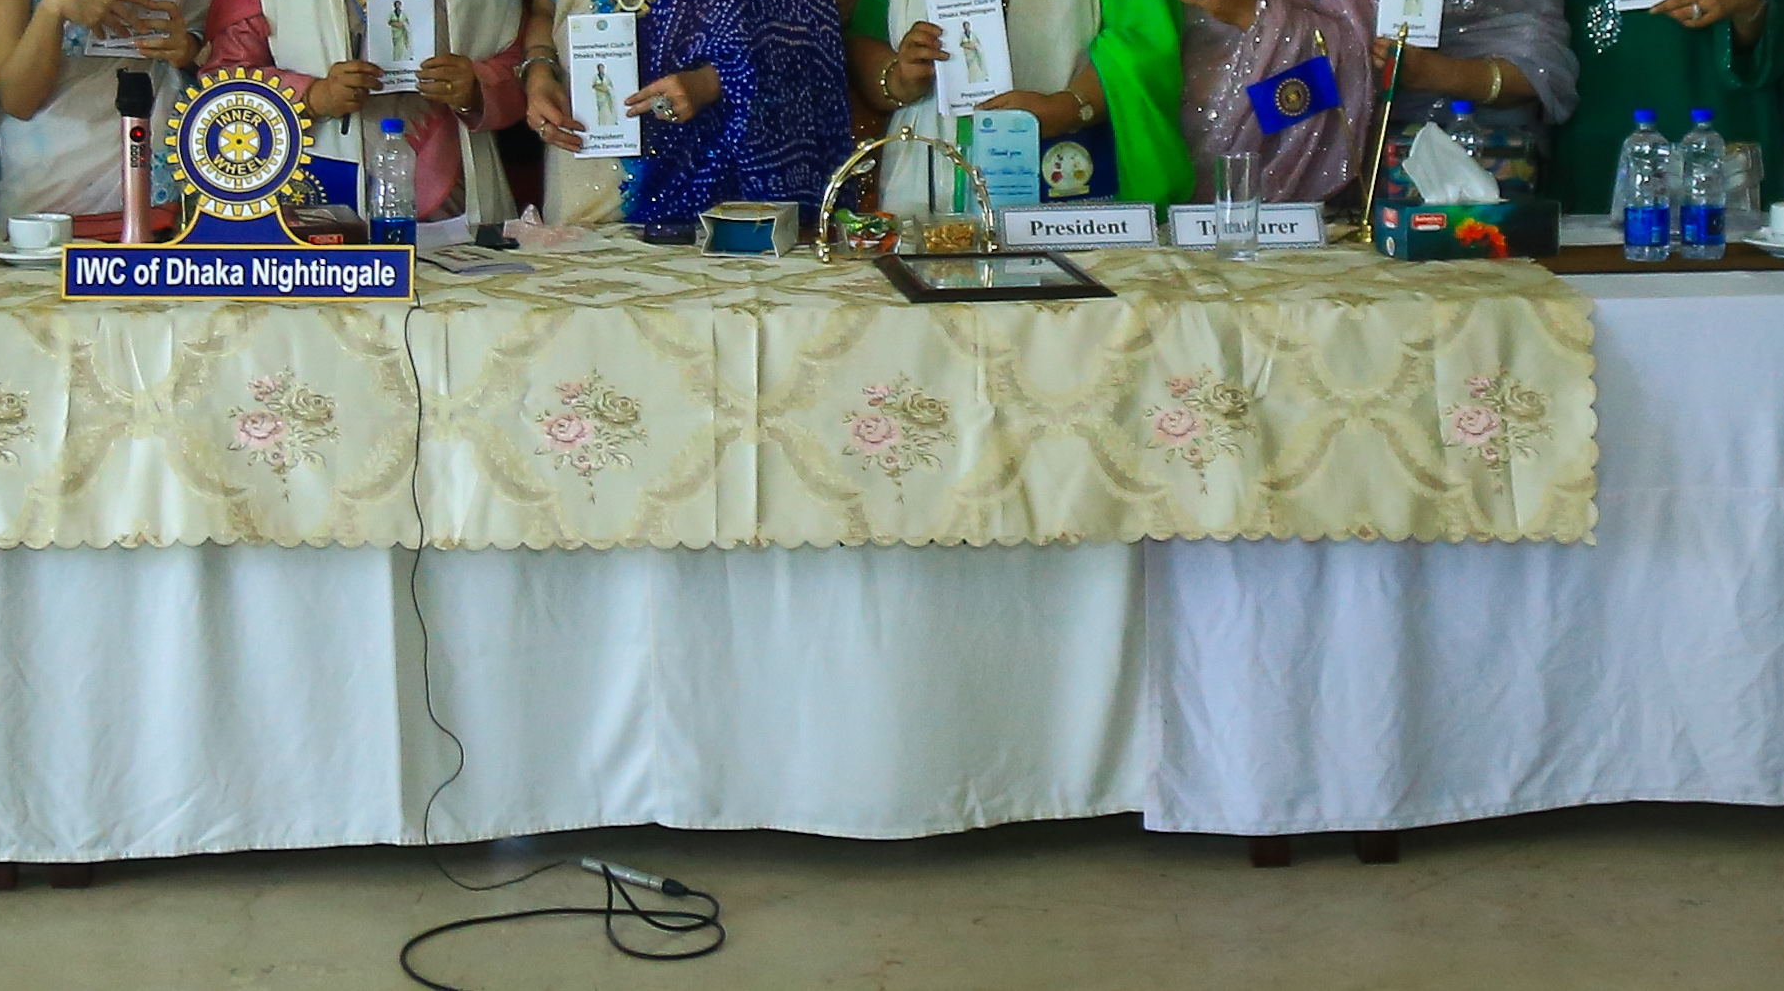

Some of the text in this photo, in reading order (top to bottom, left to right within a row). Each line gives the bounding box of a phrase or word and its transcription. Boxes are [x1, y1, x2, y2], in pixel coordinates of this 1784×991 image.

[216, 109, 262, 128] INNER
[213, 153, 268, 175] WHEEL
[1029, 219, 1129, 236] President
[75, 256, 396, 294] IWC of Dhaka Nightingale
